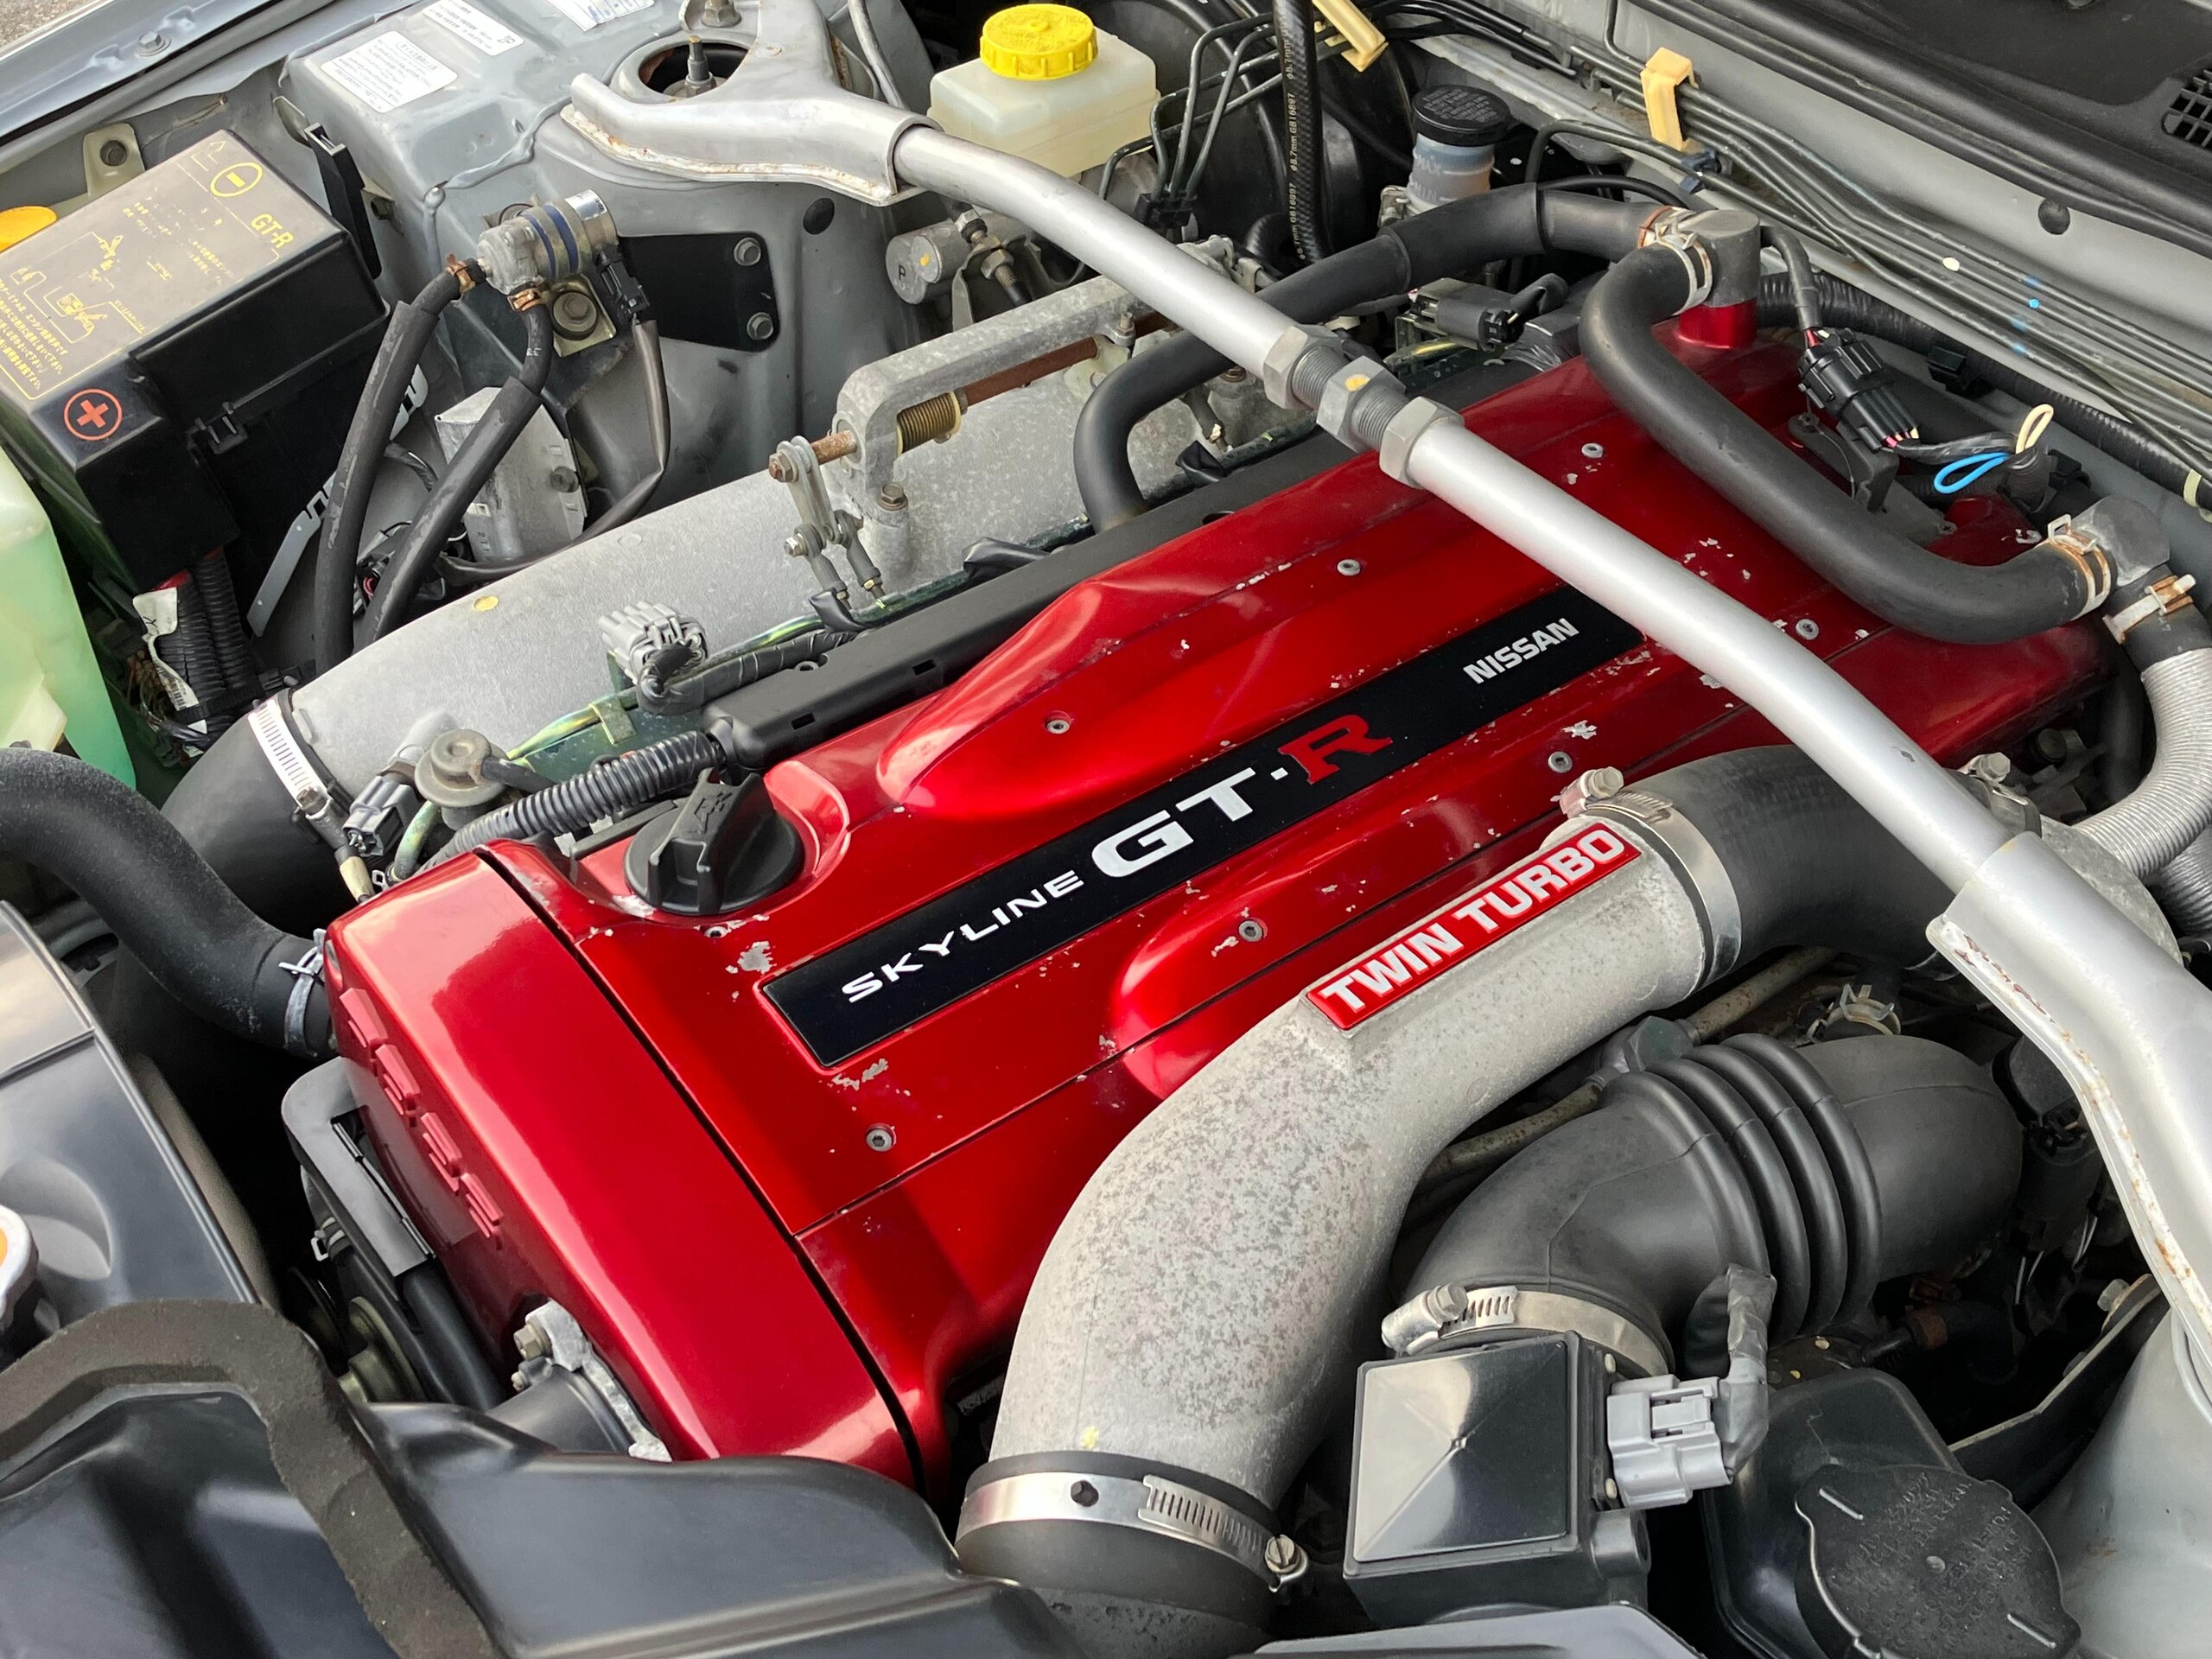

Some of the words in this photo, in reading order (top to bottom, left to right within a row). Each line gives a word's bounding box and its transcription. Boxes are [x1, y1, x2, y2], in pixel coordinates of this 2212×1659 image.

[251, 213, 295, 249] GT-R
[1463, 618, 1580, 684] NISSAN
[842, 870, 1084, 1002] SKYLINE
[1318, 923, 1464, 1014] TWIN
[1452, 830, 1625, 934] TURBO
